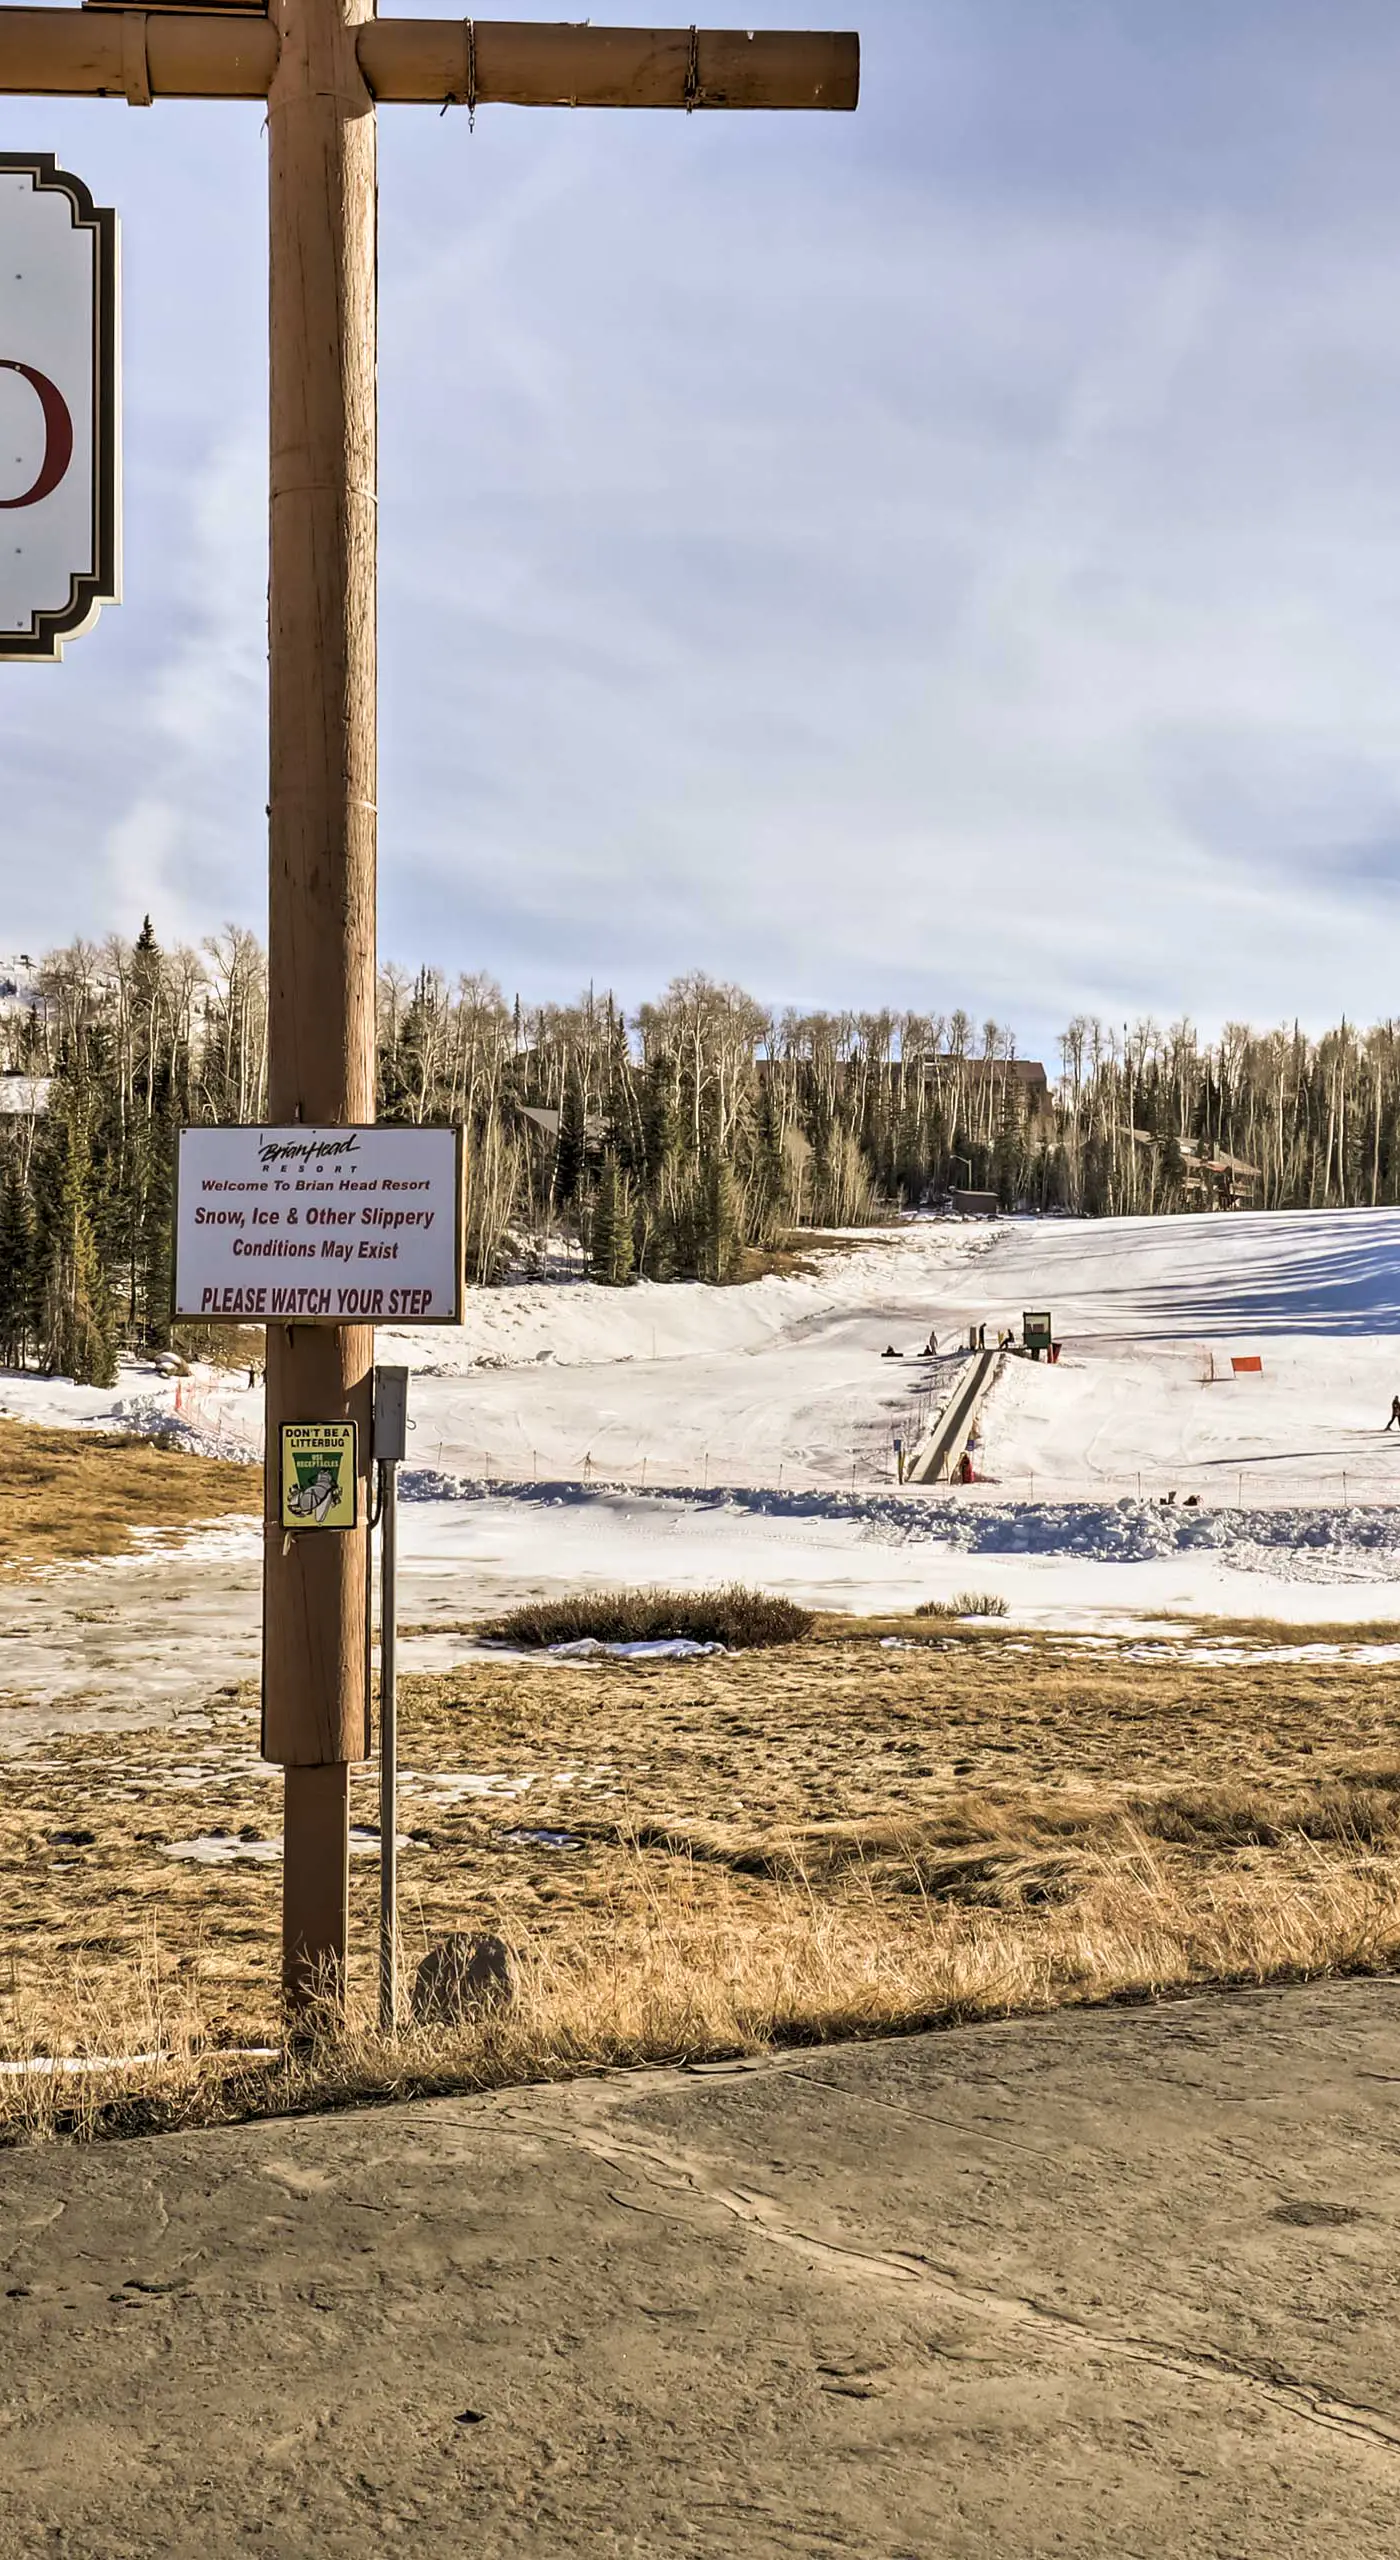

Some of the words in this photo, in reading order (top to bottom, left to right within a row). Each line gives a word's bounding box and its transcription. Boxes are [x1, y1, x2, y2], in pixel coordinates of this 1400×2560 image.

[262, 1165, 358, 1173] RESORT
[202, 1180, 268, 1191] Welcome
[274, 1180, 290, 1190] To
[295, 1180, 333, 1191] Brian
[339, 1180, 377, 1190] Head
[382, 1180, 430, 1190] Resort
[194, 1207, 245, 1228] Snow,
[252, 1208, 279, 1225] Ice
[287, 1208, 298, 1224] &
[306, 1208, 356, 1225] Other
[361, 1208, 434, 1229] Slippery
[232, 1239, 316, 1257] Conditions
[321, 1240, 354, 1262] May
[358, 1242, 398, 1259] Exist
[201, 1287, 266, 1312] PLEASE
[271, 1288, 330, 1314] WATCH
[336, 1288, 382, 1314] YOUR
[388, 1289, 432, 1314] STEP
[286, 1429, 320, 1437] DON'T
[324, 1429, 338, 1437] BE
[343, 1429, 349, 1437] A
[291, 1439, 344, 1447] LITTERBUG
